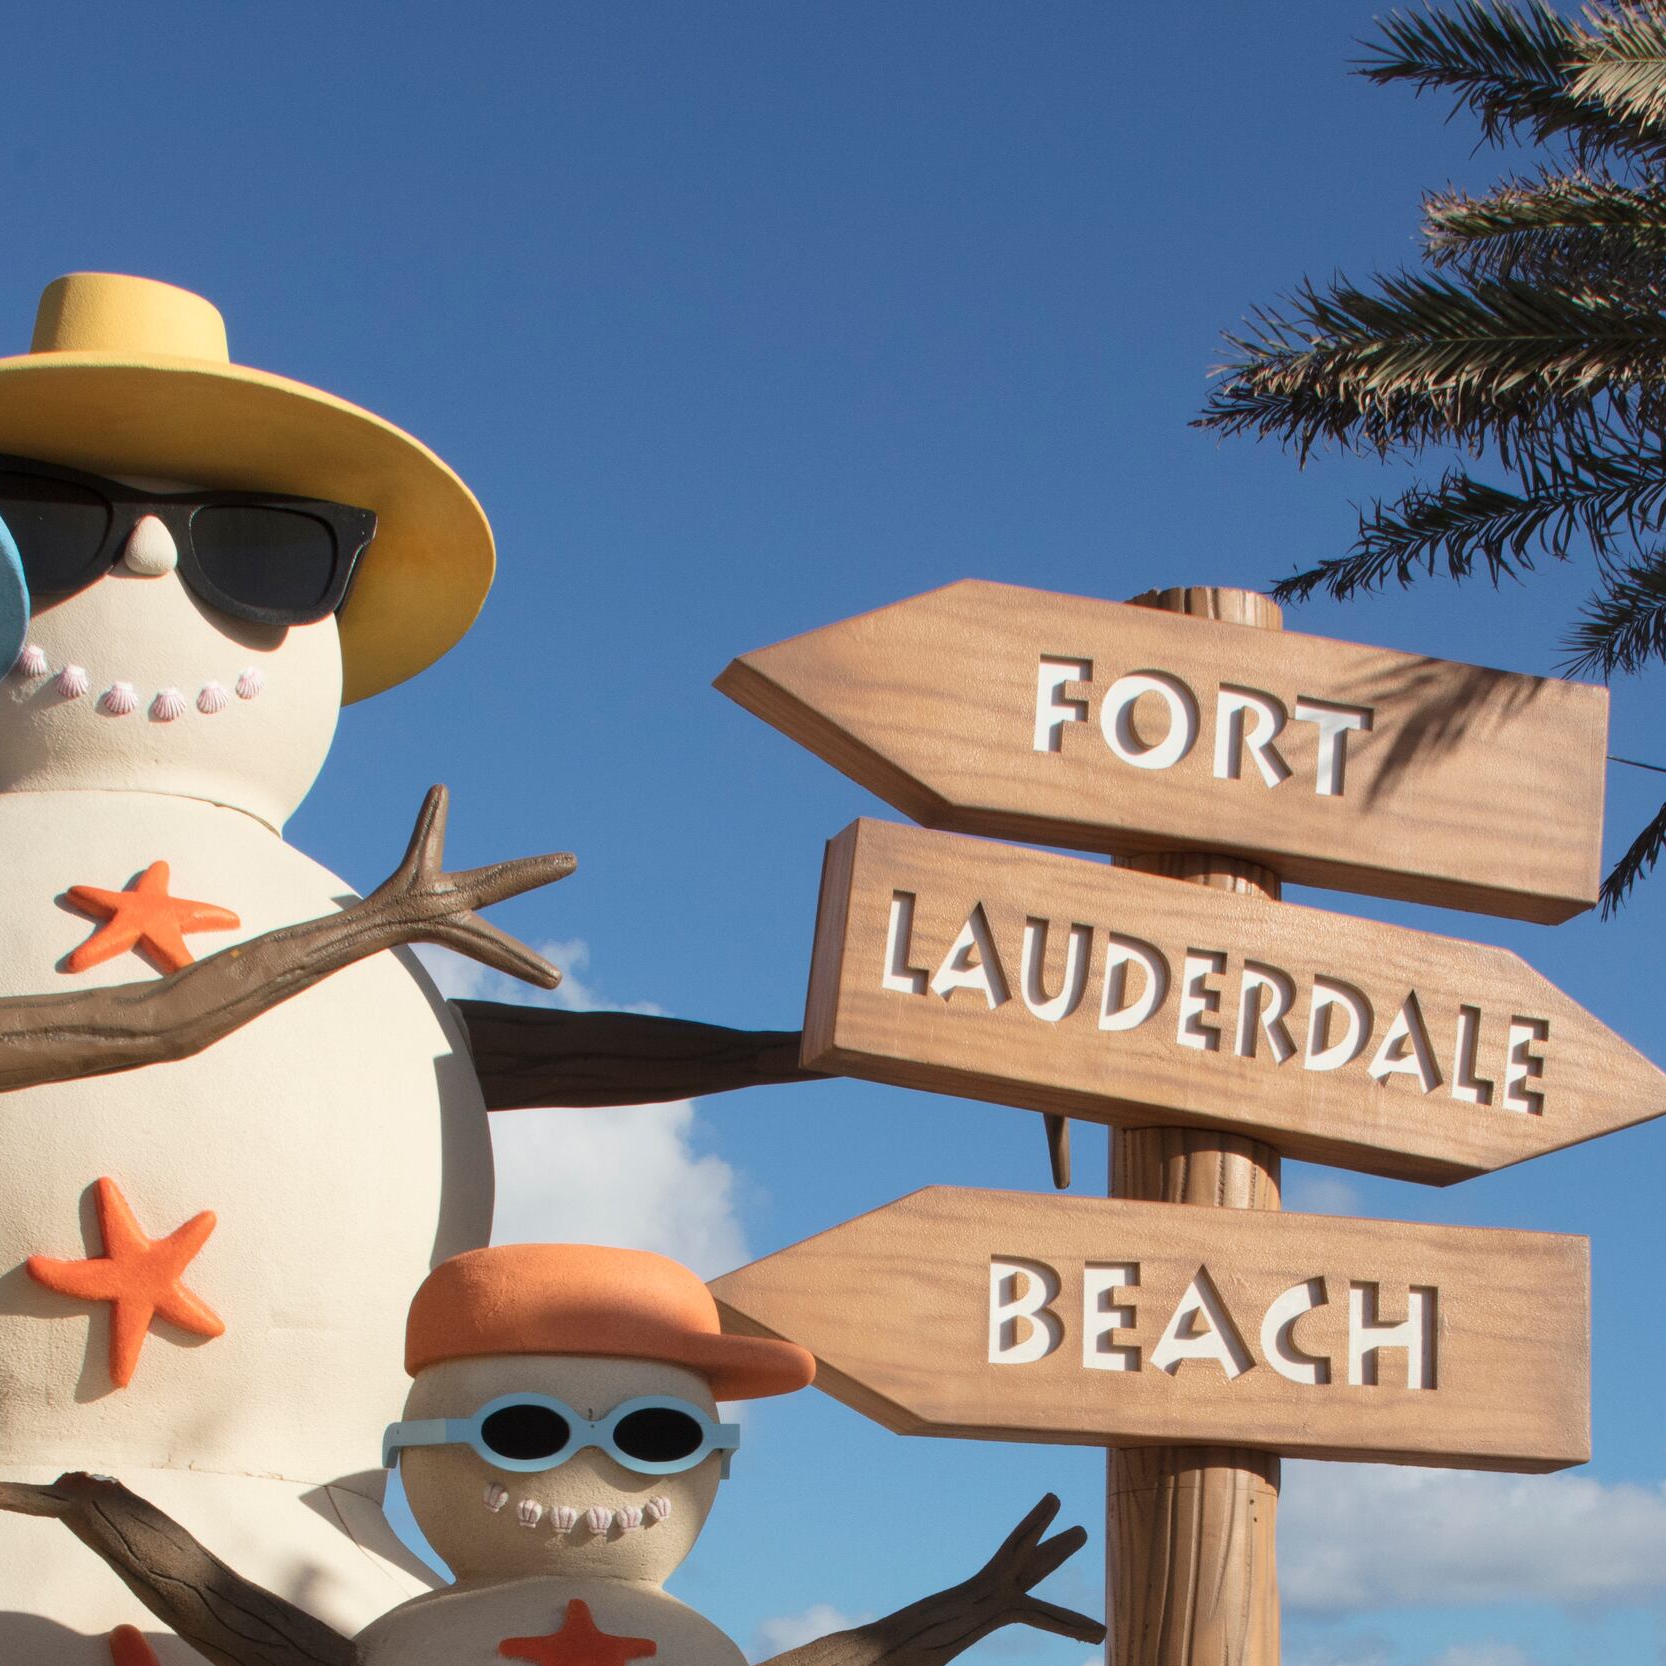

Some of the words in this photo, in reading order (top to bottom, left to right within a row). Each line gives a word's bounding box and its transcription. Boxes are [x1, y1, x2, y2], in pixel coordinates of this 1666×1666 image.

[1032, 653, 1374, 797] FORT
[880, 889, 1550, 1117] LAUDERDALE
[986, 1253, 1439, 1391] BEACH
